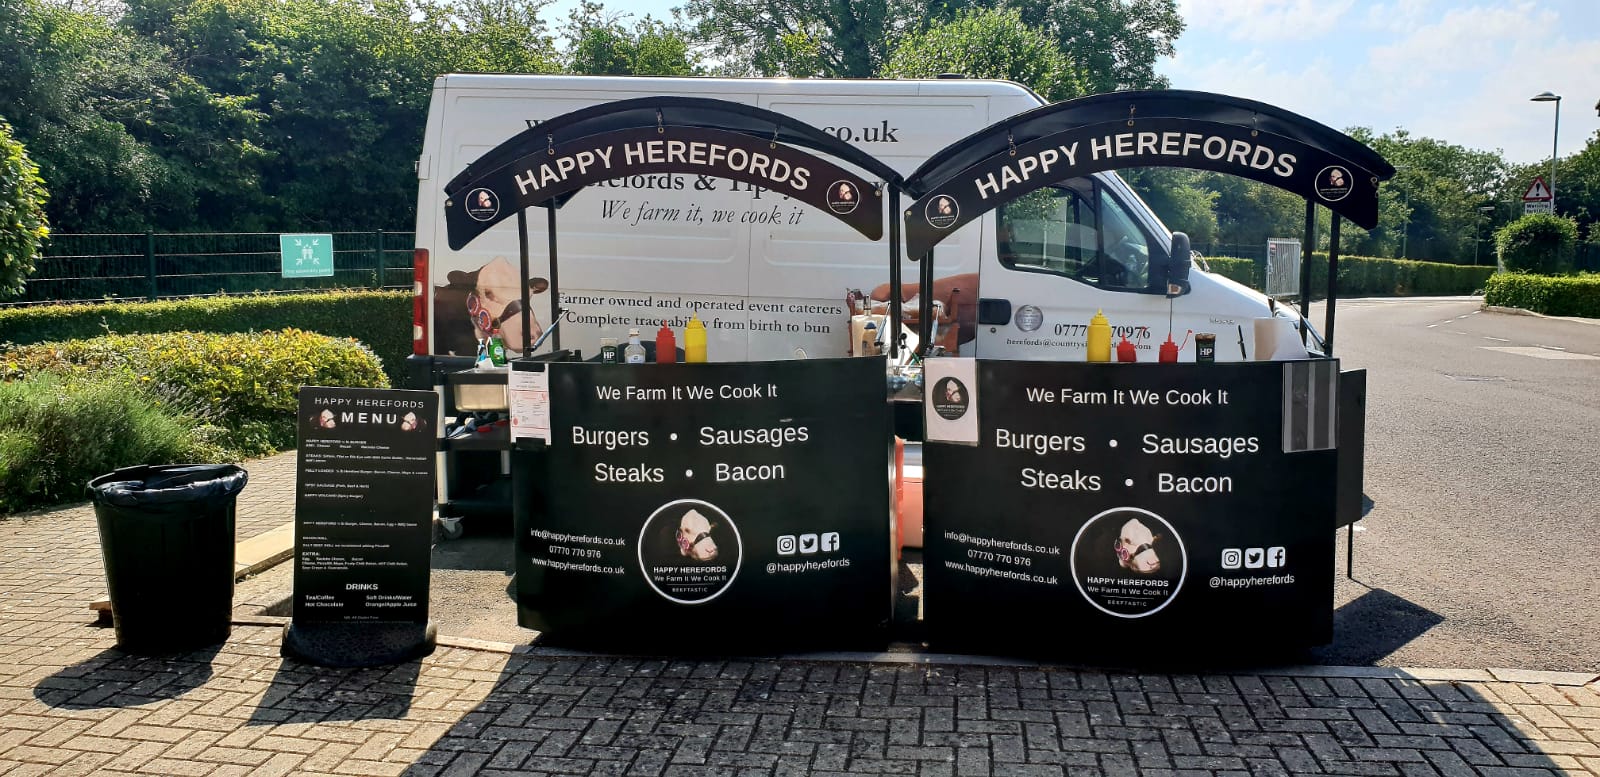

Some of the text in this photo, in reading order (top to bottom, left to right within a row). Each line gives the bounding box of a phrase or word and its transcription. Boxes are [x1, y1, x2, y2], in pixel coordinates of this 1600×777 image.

[514, 146, 613, 196] HAPPY
[624, 140, 811, 191] HEREFORDS
[975, 131, 1298, 200] HAPPY HEREFORDS
[694, 174, 717, 191] &
[602, 200, 804, 226] We farm it, we cook it
[558, 292, 842, 315] Farmer owned and operated event caterers
[566, 311, 630, 326] Complete
[713, 317, 745, 330] from
[750, 320, 781, 332] birth
[787, 322, 799, 332] to
[804, 322, 830, 334] bun
[603, 351, 615, 360] HP
[596, 384, 777, 400] We Farm It We Cook It
[1027, 387, 1229, 405] We Farm It We Cook It
[314, 397, 424, 409] HAPPY HEREFORDS
[341, 411, 397, 424] MENU
[572, 423, 809, 450] Burgers Sausages
[996, 428, 1259, 459] Burgers Sausages
[594, 462, 785, 484] Steaks Bacon
[1021, 467, 1232, 493] Steaks Bacon
[530, 528, 625, 546] info@happyherefords.co.uk
[944, 530, 1060, 556] info@happyherefords.co.uk
[549, 545, 601, 559] 07770 770 976
[967, 549, 1031, 567] 07770 770 976
[532, 556, 625, 575] www.happyherefords.co.uk
[654, 565, 727, 574] HAPPY HEREFORDS
[945, 560, 1058, 586] www.happyherefords.co.uk
[346, 583, 378, 591] DRINKS
[1087, 576, 1169, 587] HAPPY HEREFORDS
[1209, 574, 1295, 589] @happyherefords
[1142, 588, 1161, 596] Cook
